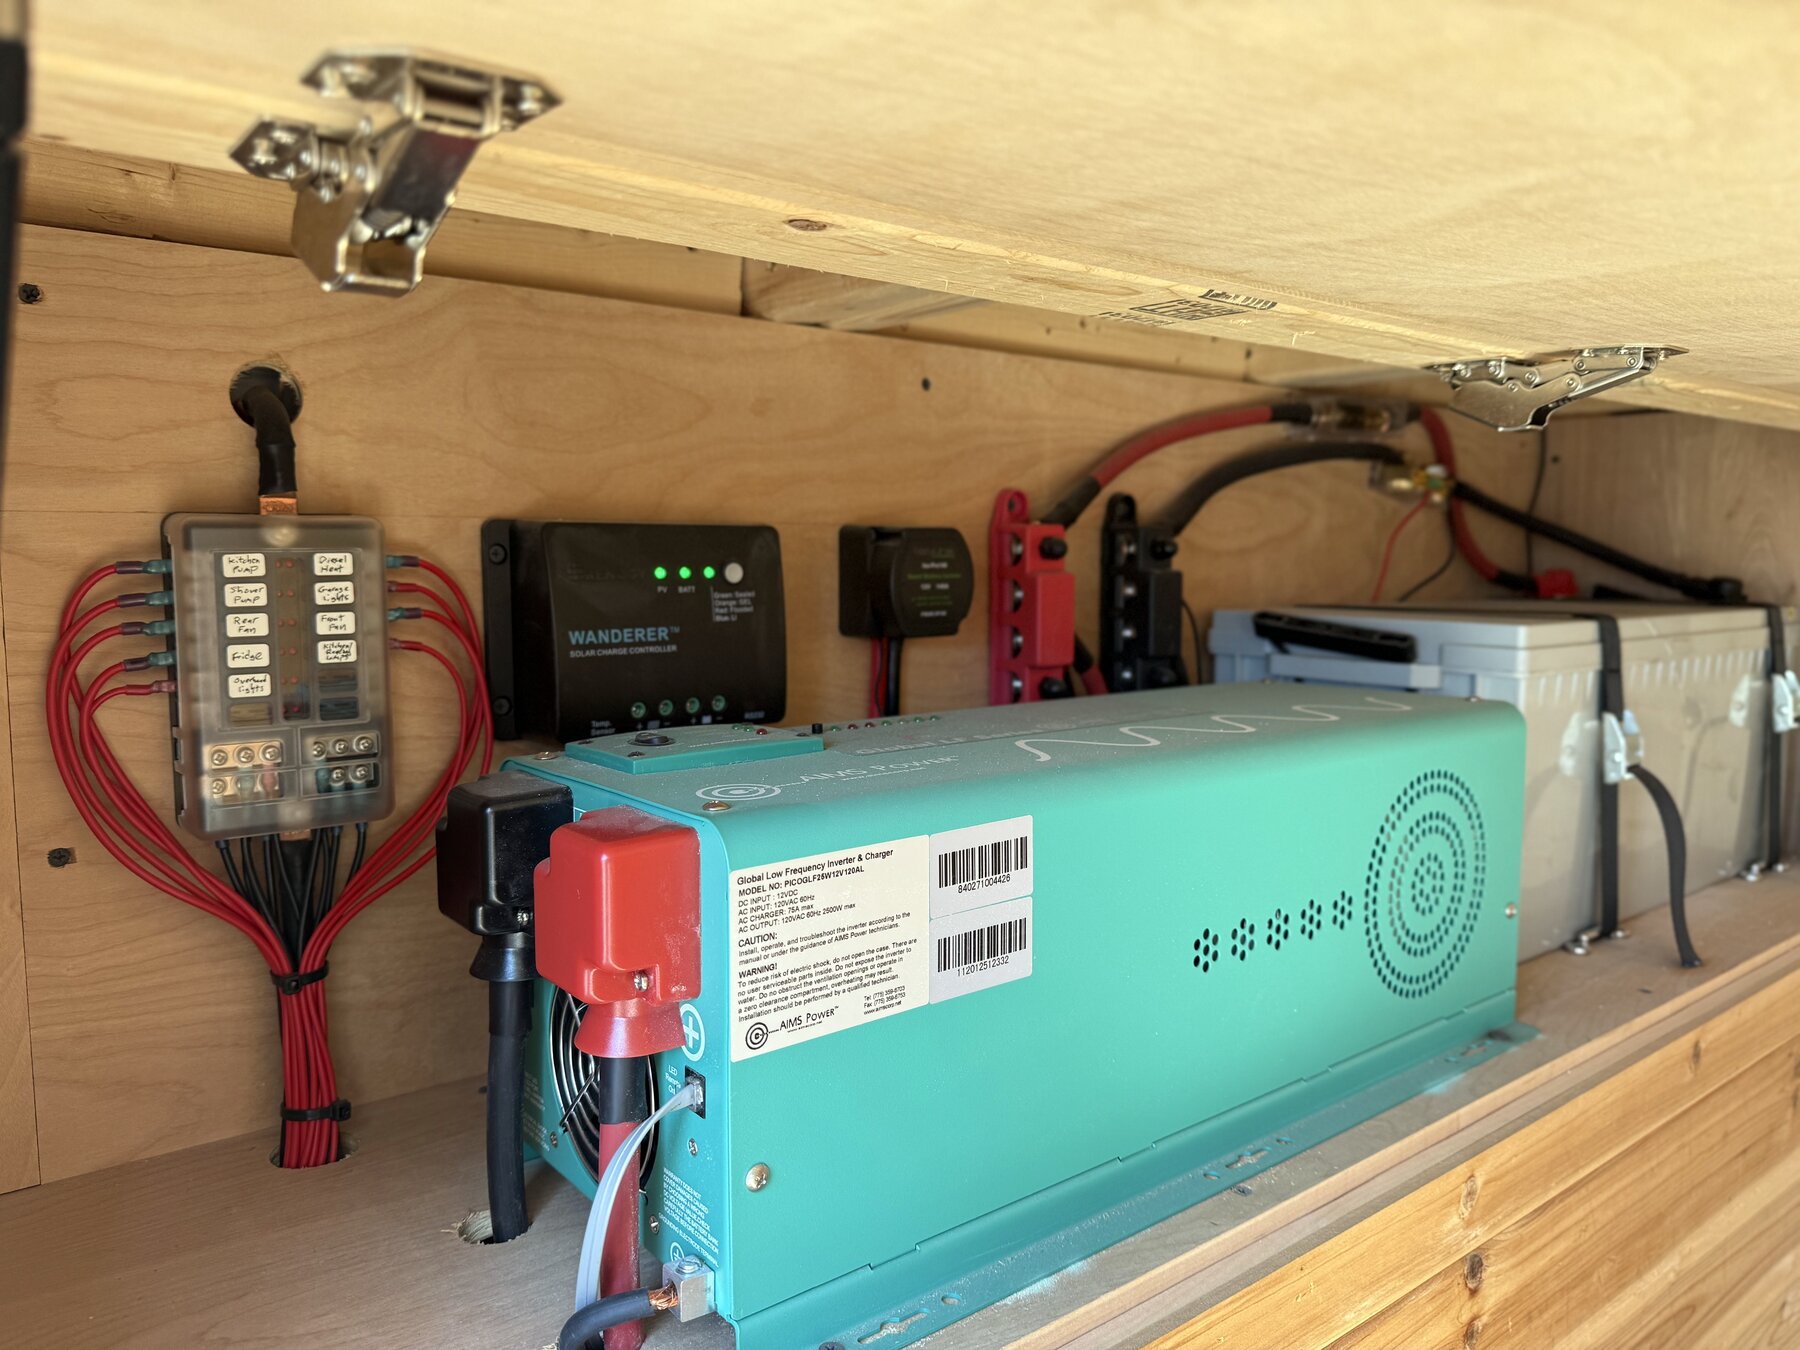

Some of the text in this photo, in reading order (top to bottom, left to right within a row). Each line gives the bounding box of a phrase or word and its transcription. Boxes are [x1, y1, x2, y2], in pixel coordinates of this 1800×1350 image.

[657, 586, 695, 594] PV BATT
[569, 645, 677, 658] SOLAR CHARGE CONTROLLER
[801, 768, 867, 783] AIMS
[737, 850, 893, 885] Global Low Frequency Inverter & Charger
[739, 885, 767, 897] MODEL
[769, 882, 782, 891] NO:
[958, 873, 1010, 893] 840271004426
[738, 899, 748, 908] DC
[750, 894, 771, 905] INPUT
[777, 889, 798, 899] 12VDC
[738, 908, 748, 916] AC
[774, 897, 798, 908] 120VAC
[738, 917, 748, 925] AC
[788, 906, 800, 914] 75A
[738, 925, 748, 933] AC
[782, 913, 805, 924] 120VAC
[738, 932, 777, 948] CAUTION:
[787, 937, 798, 945] and
[800, 929, 835, 942] troubleshoot
[847, 922, 867, 933] inverter
[869, 916, 894, 926] according
[739, 954, 762, 965] manual
[763, 951, 770, 960] or
[771, 949, 788, 958] under
[800, 940, 826, 952] guidance
[834, 933, 849, 942] AIMS
[850, 930, 867, 938] Power
[739, 963, 777, 979] WARNING!
[747, 986, 761, 994] user
[763, 977, 797, 990] serviceable
[798, 973, 813, 982] parts
[845, 961, 854, 969] not
[855, 957, 874, 966] expose
[885, 949, 905, 958] inverter
[748, 976, 769, 985] reduce
[790, 965, 811, 975] electric
[841, 954, 850, 962] not
[851, 951, 865, 959] open
[957, 955, 1009, 977] 112012512332
[778, 983, 802, 994] obstruct
[814, 973, 842, 984] ventilation
[844, 966, 868, 977] openings
[877, 959, 897, 968] operate
[739, 1009, 772, 1022] Installation
[773, 1002, 793, 1013] should
[804, 991, 833, 1006] performed
[847, 980, 870, 993] qualified
[744, 1004, 757, 1012] zero
[759, 996, 788, 1008] clearance
[831, 976, 863, 988] overheating
[780, 1015, 802, 1031] AIMS
[668, 1064, 678, 1076] LED
